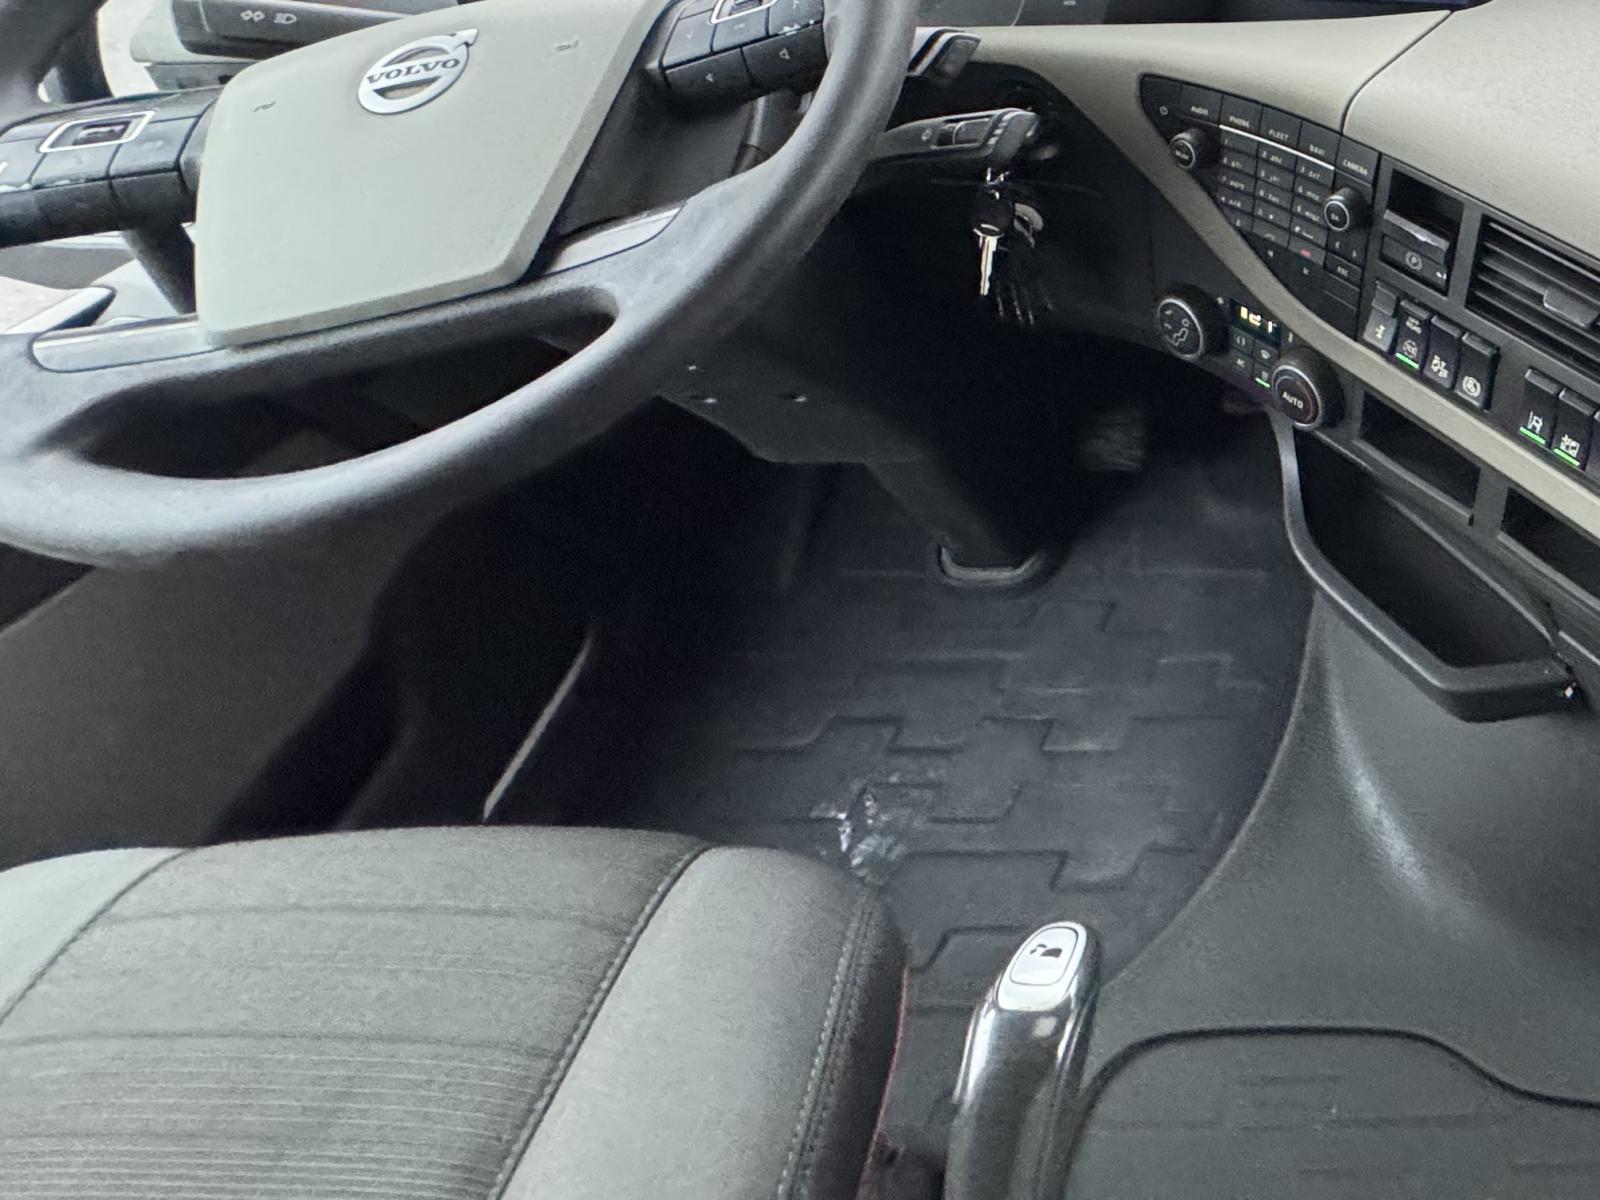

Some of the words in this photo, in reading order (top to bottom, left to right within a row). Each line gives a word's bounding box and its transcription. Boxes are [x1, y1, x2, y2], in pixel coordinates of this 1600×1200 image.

[366, 58, 461, 84] VOLVO
[1228, 115, 1250, 128] PHONE
[1268, 128, 1290, 142] FLEET
[1342, 158, 1368, 176] CAMERA
[1282, 391, 1304, 409] AUTO
